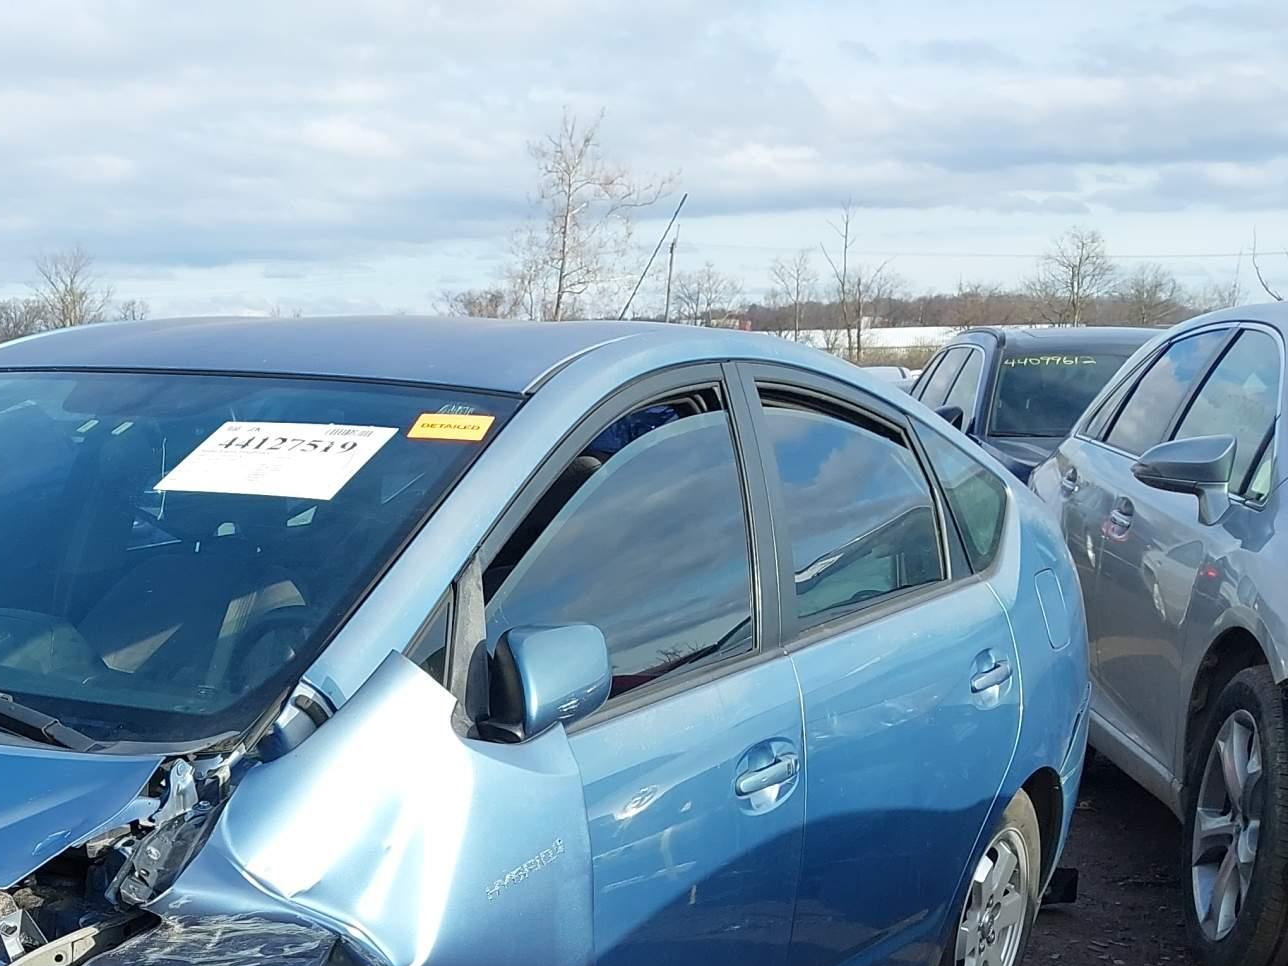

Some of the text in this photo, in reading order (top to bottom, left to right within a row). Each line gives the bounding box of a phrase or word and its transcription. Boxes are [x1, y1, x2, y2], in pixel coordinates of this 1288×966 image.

[1004, 356, 1097, 367] 44099612
[420, 422, 481, 431] DETAILED
[218, 435, 358, 454] 44127519
